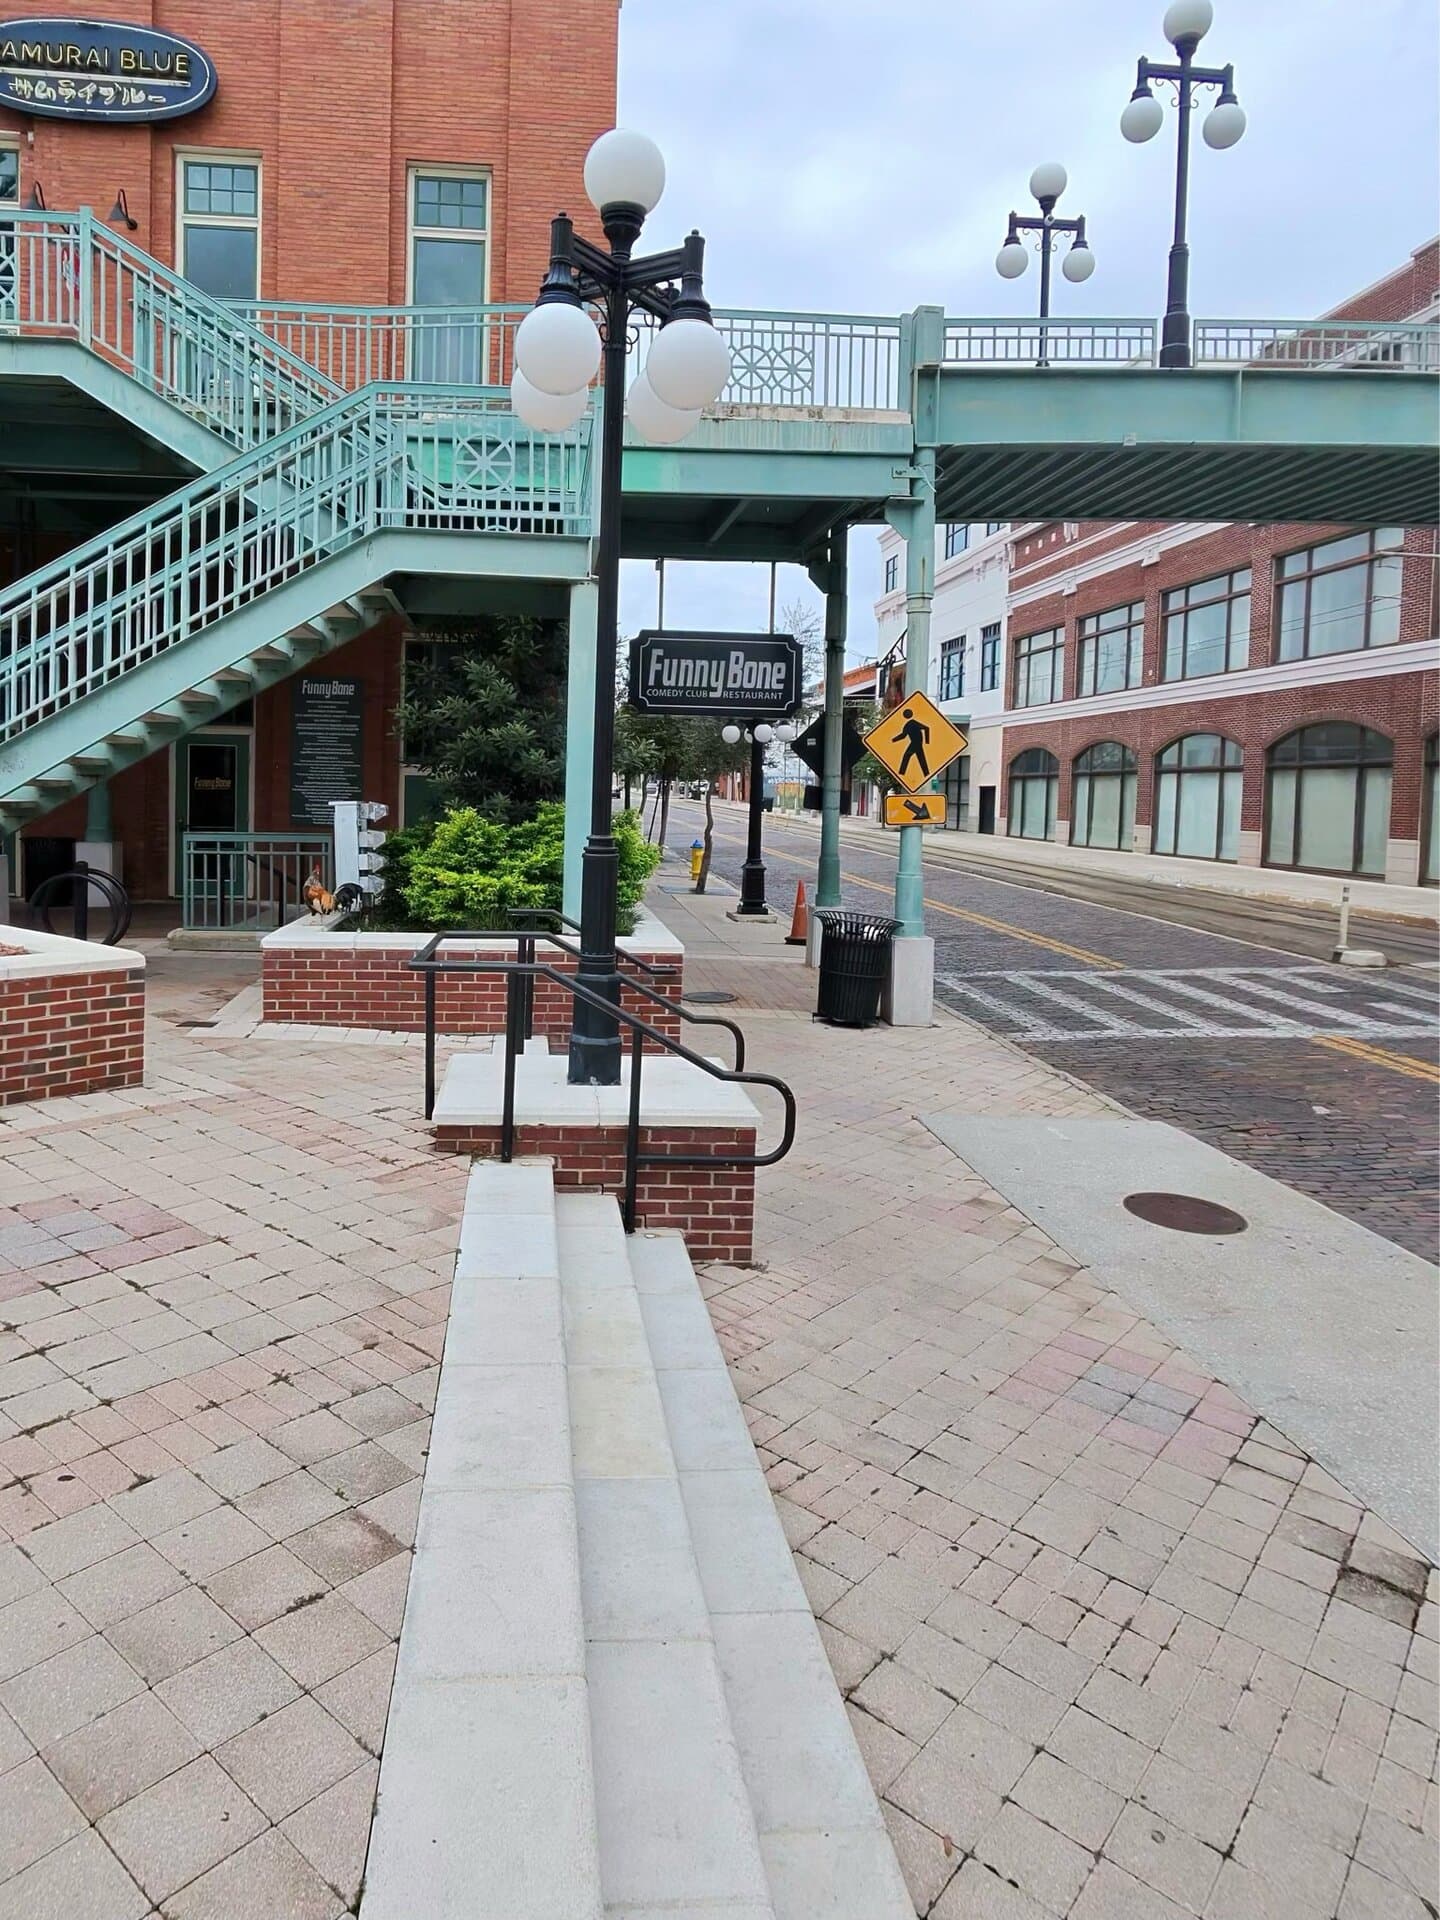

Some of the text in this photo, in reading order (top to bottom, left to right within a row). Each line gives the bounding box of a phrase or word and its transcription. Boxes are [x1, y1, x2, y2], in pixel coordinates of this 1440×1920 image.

[0, 40, 189, 74] AMURAI BLUE
[646, 688, 783, 700] COMEDY CLUB RESTAURANT
